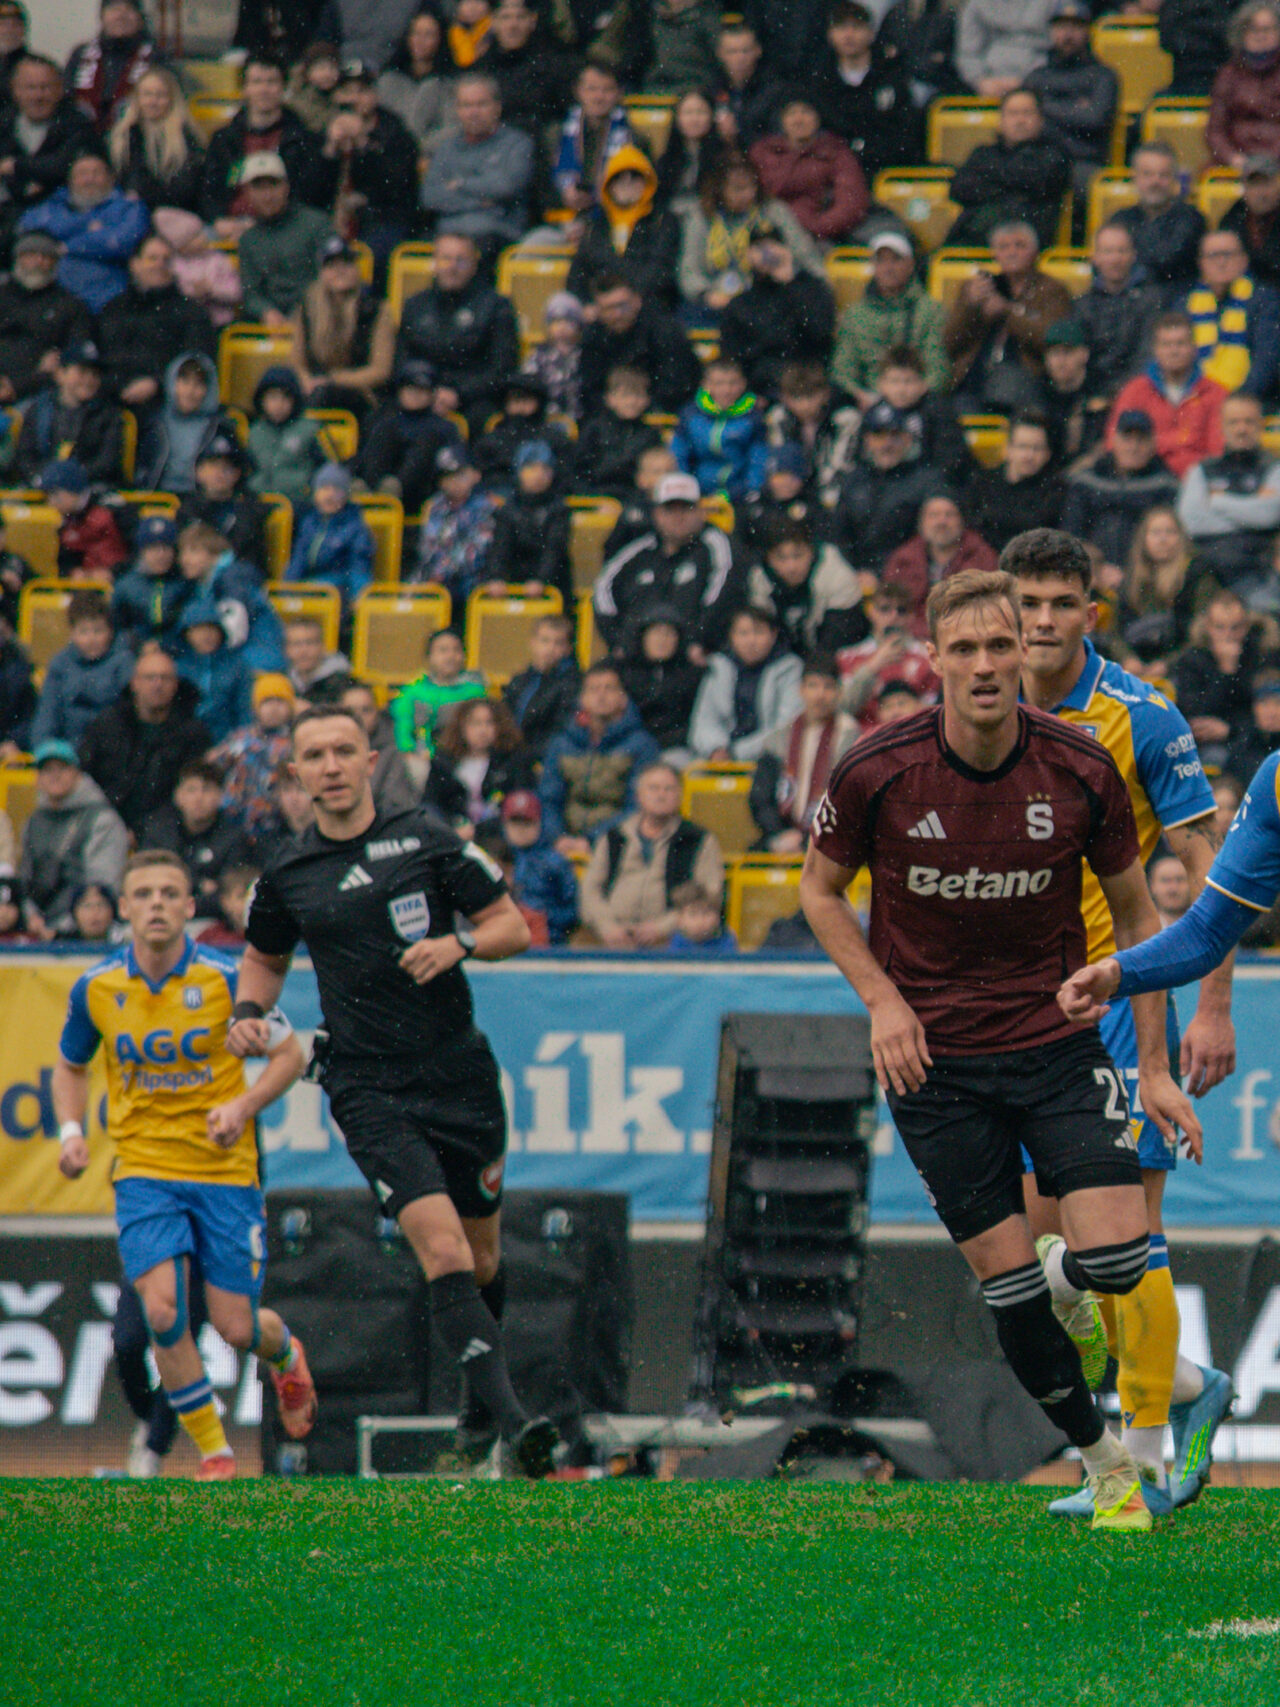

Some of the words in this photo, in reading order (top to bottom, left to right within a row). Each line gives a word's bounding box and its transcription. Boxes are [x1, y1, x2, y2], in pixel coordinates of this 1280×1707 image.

[1026, 803, 1054, 840] S
[908, 864, 1052, 899] Betano
[394, 898, 423, 914] FIFA
[115, 1028, 211, 1065] AGC
